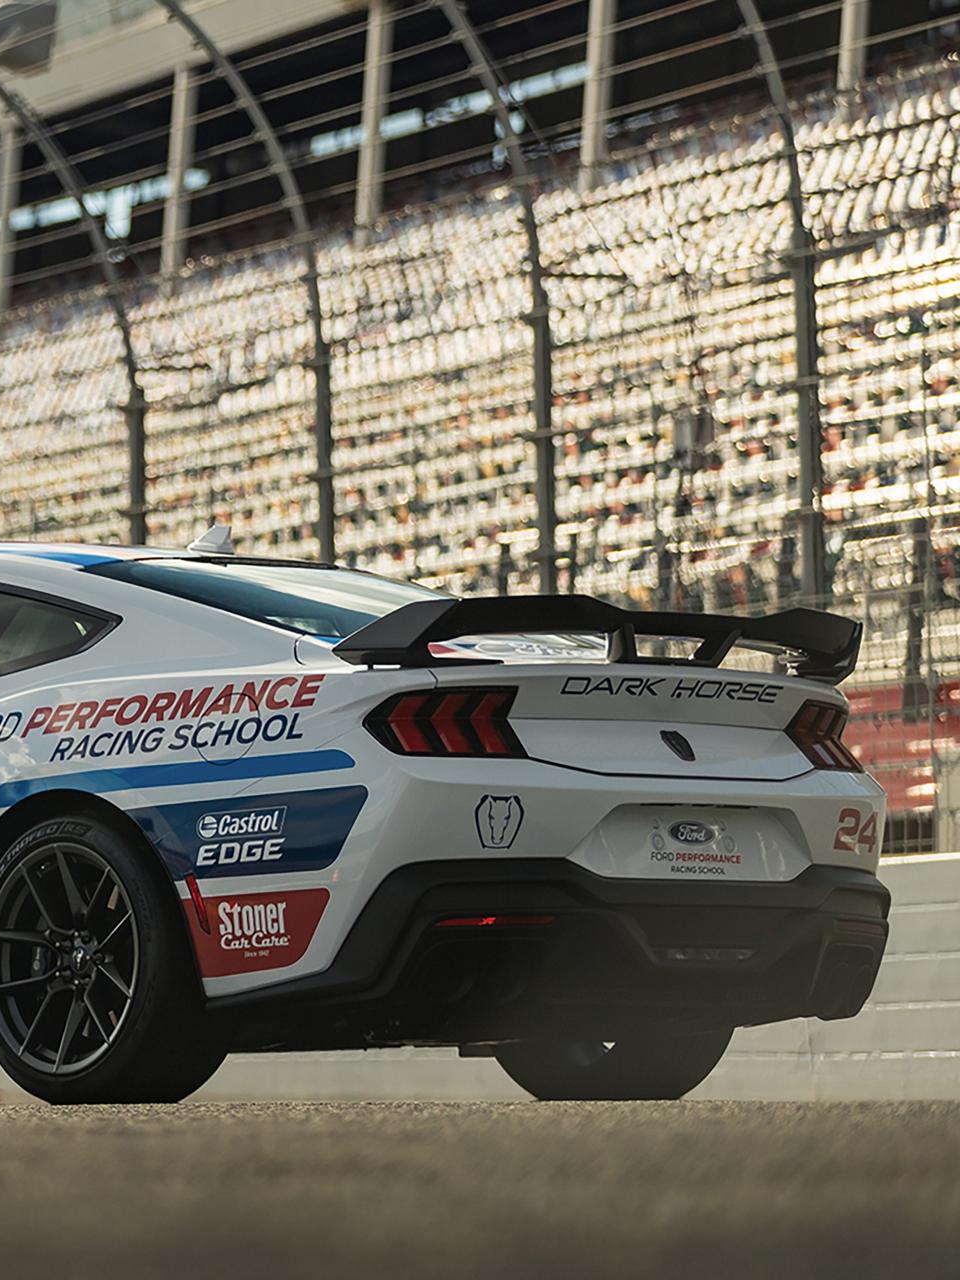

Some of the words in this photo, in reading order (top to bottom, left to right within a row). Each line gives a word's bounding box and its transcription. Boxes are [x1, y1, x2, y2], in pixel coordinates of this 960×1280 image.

[560, 676, 666, 697] DARK
[670, 679, 784, 703] HORSE
[20, 673, 327, 738] PERFORMANCE
[49, 726, 164, 763] RACING
[167, 713, 303, 750] SCHOOL
[218, 811, 280, 836] Castrol
[678, 824, 707, 841] Ford
[832, 807, 879, 854] 24
[196, 838, 287, 867] EDGE
[650, 851, 675, 862] FORD
[675, 852, 742, 864] PERFORMANCE
[670, 865, 697, 874] RACING
[697, 866, 726, 875] SCHOOL
[217, 901, 287, 937] Stoner
[220, 934, 251, 950] Car
[251, 931, 290, 948] Care
